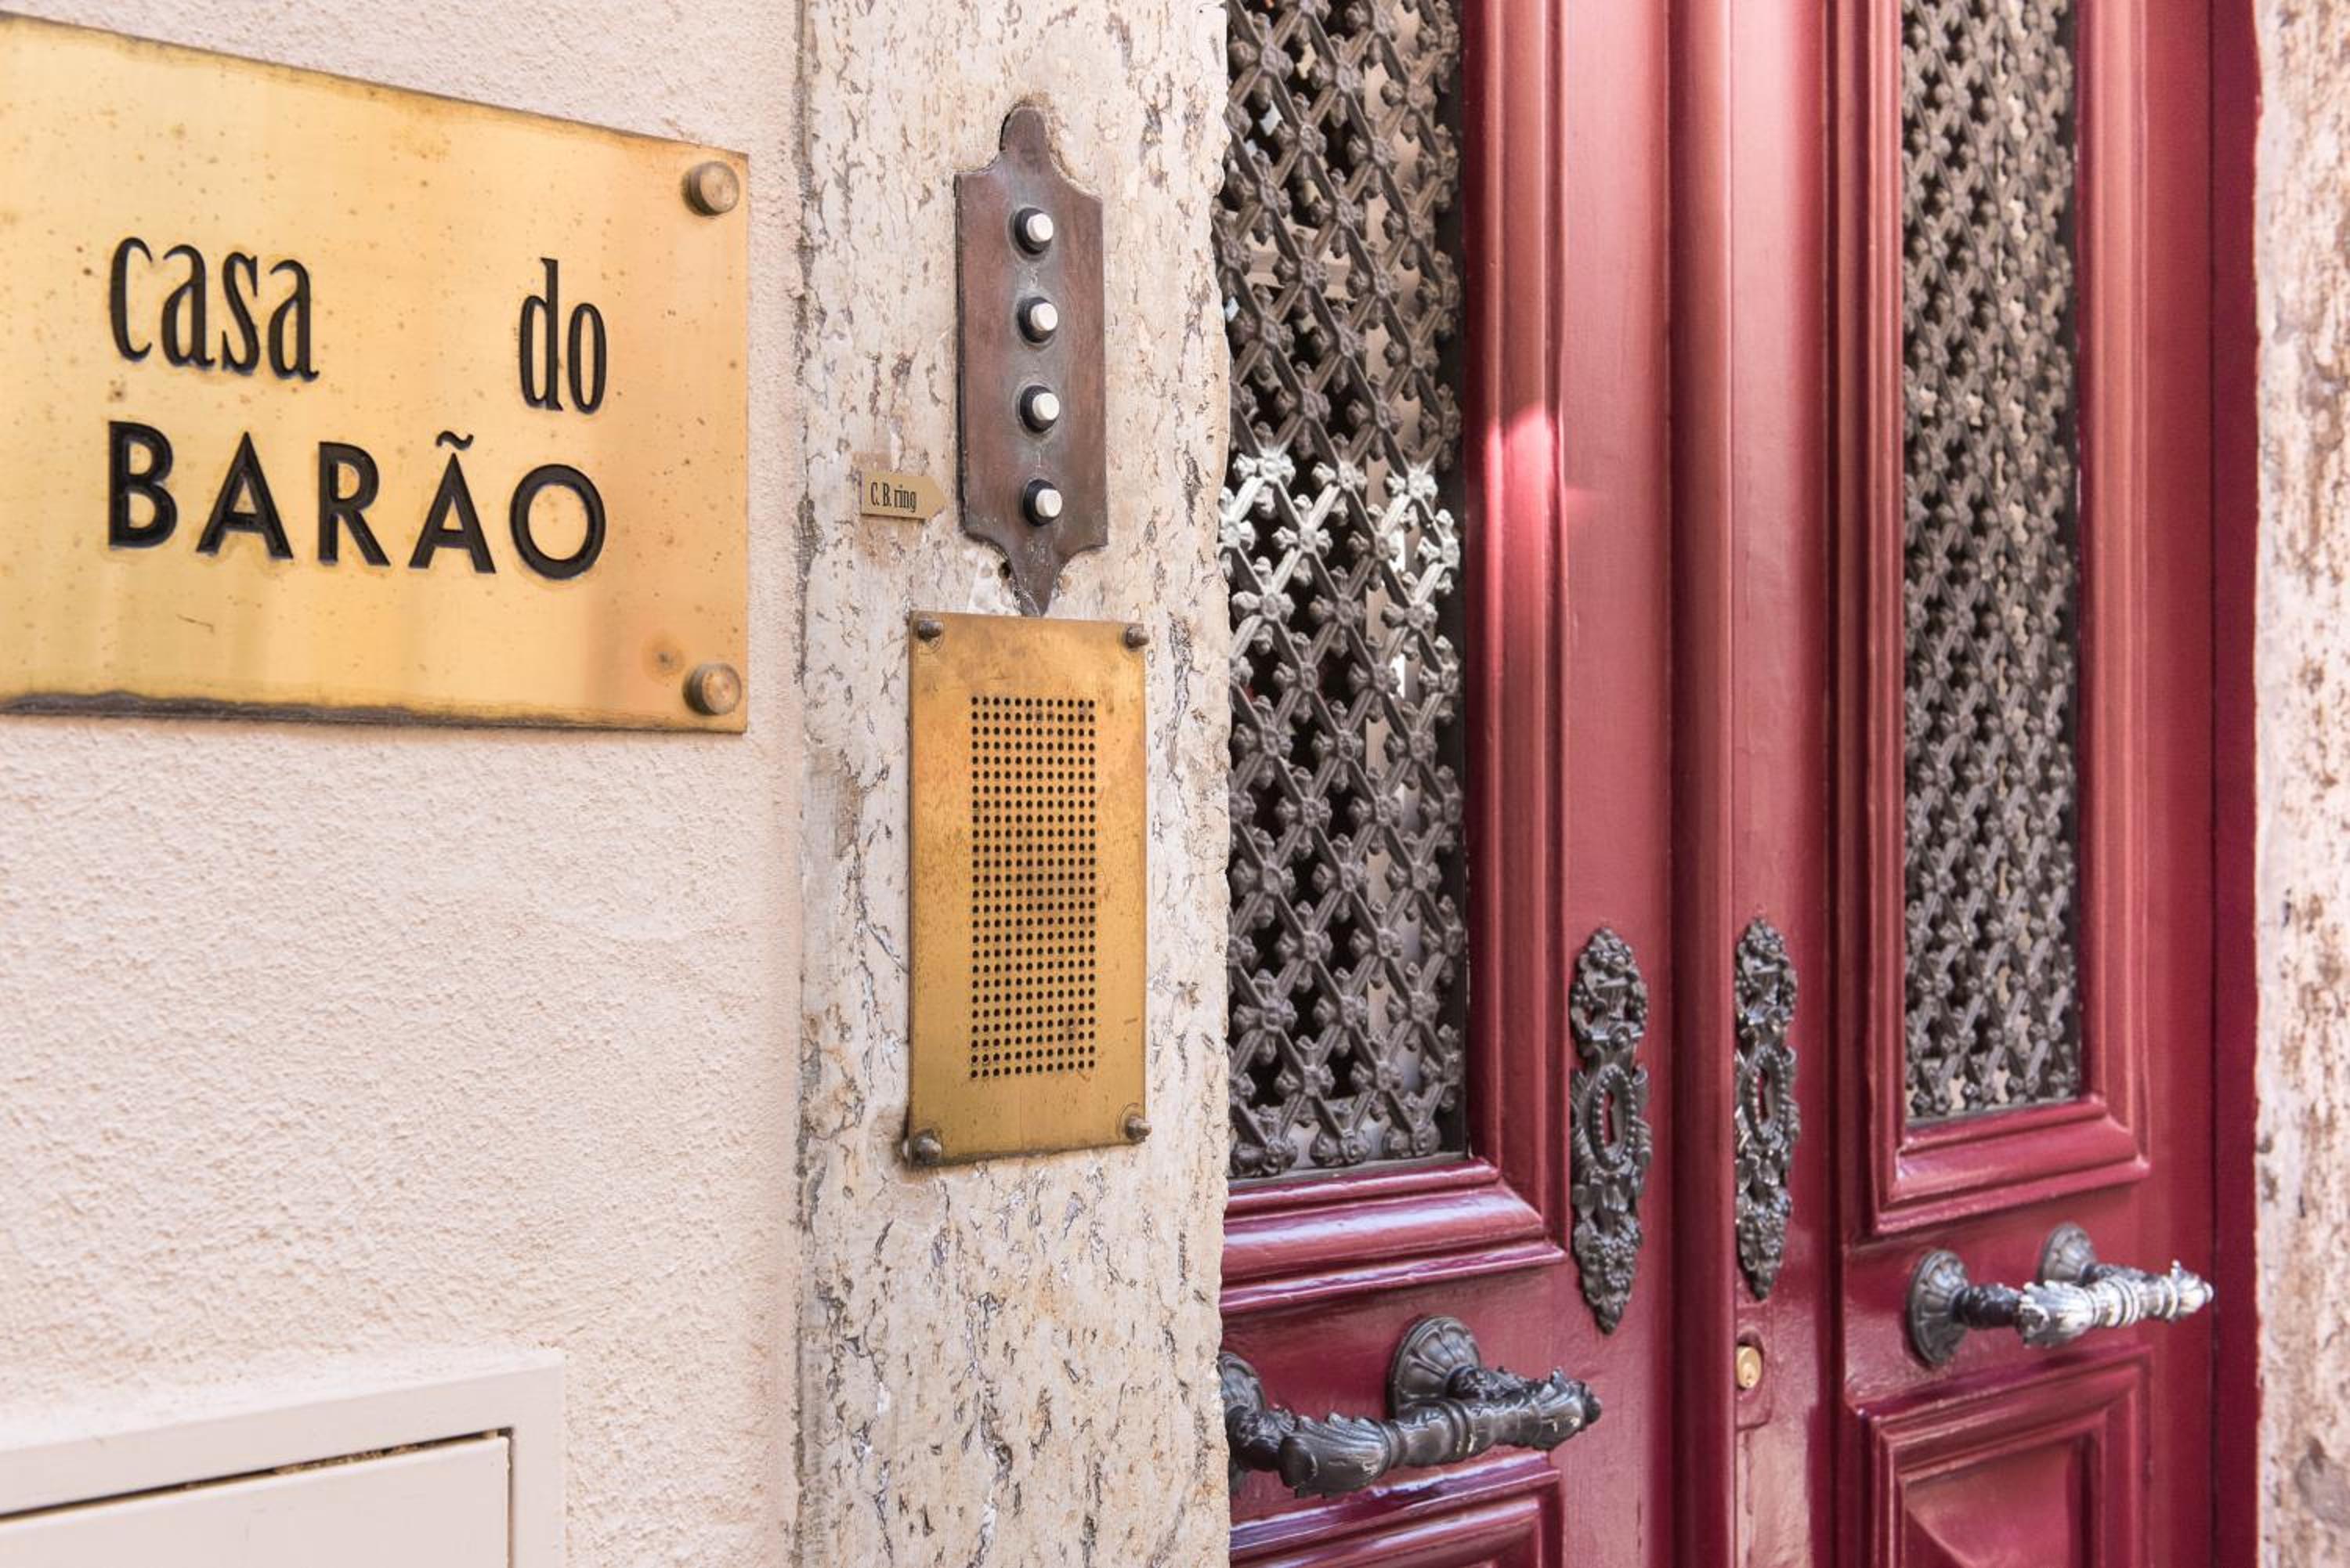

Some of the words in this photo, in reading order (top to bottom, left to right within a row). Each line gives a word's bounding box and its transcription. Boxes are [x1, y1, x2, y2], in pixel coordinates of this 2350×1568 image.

[109, 237, 320, 381] casa
[518, 257, 607, 414] do
[107, 420, 607, 580] BARÃO
[894, 484, 916, 513] ring
